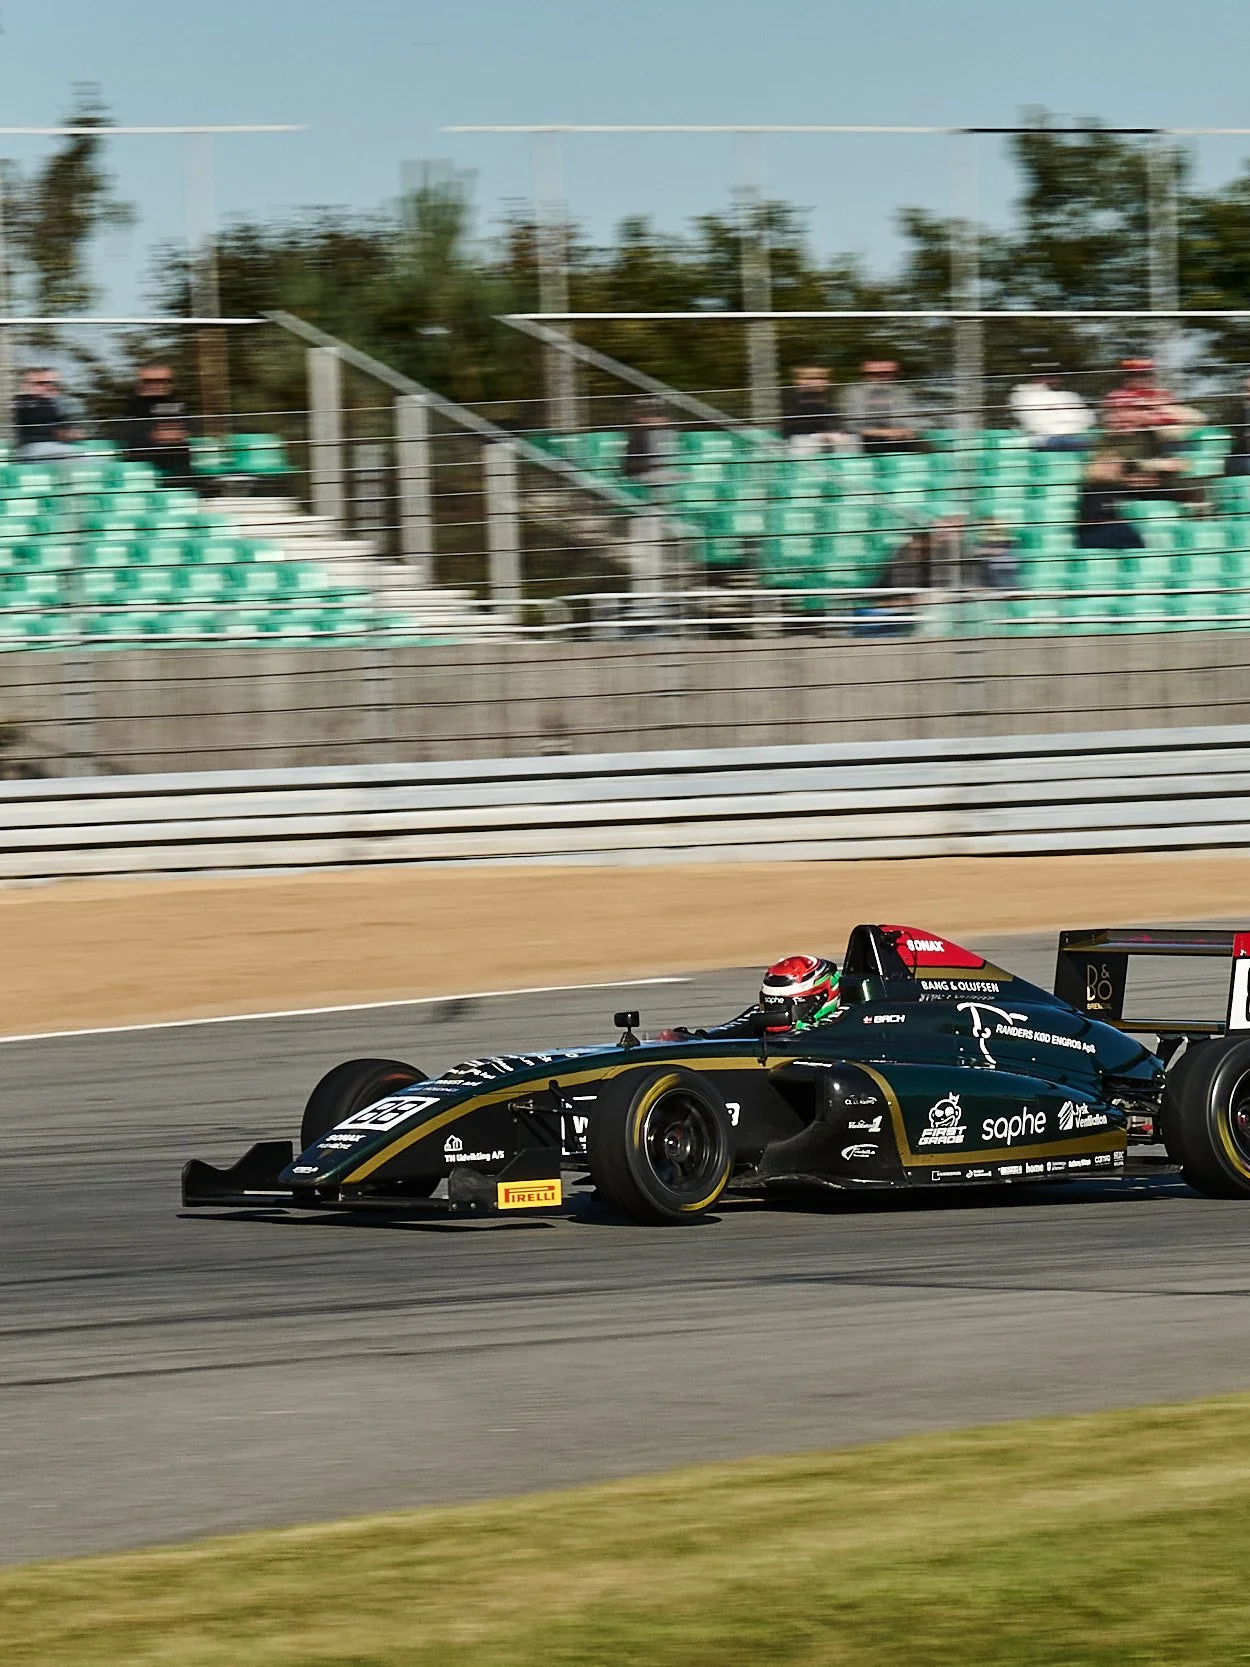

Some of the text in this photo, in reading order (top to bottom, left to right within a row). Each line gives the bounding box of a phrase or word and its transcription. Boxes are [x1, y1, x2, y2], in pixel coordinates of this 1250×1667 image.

[906, 939, 945, 952] SONAX
[921, 980, 1000, 993] BANG & OLUFSEN
[873, 1014, 906, 1024] BACH
[995, 1023, 1034, 1041] RANDERS
[1033, 1031, 1051, 1044] KØD
[1051, 1033, 1082, 1051] ENGROS
[348, 1100, 427, 1125] 88
[981, 1105, 1047, 1146] saphe
[1075, 1113, 1108, 1129] Ventilation
[921, 1125, 967, 1138] FIRST
[918, 1134, 965, 1146] GRADE
[503, 1185, 556, 1204] PIRELLI
